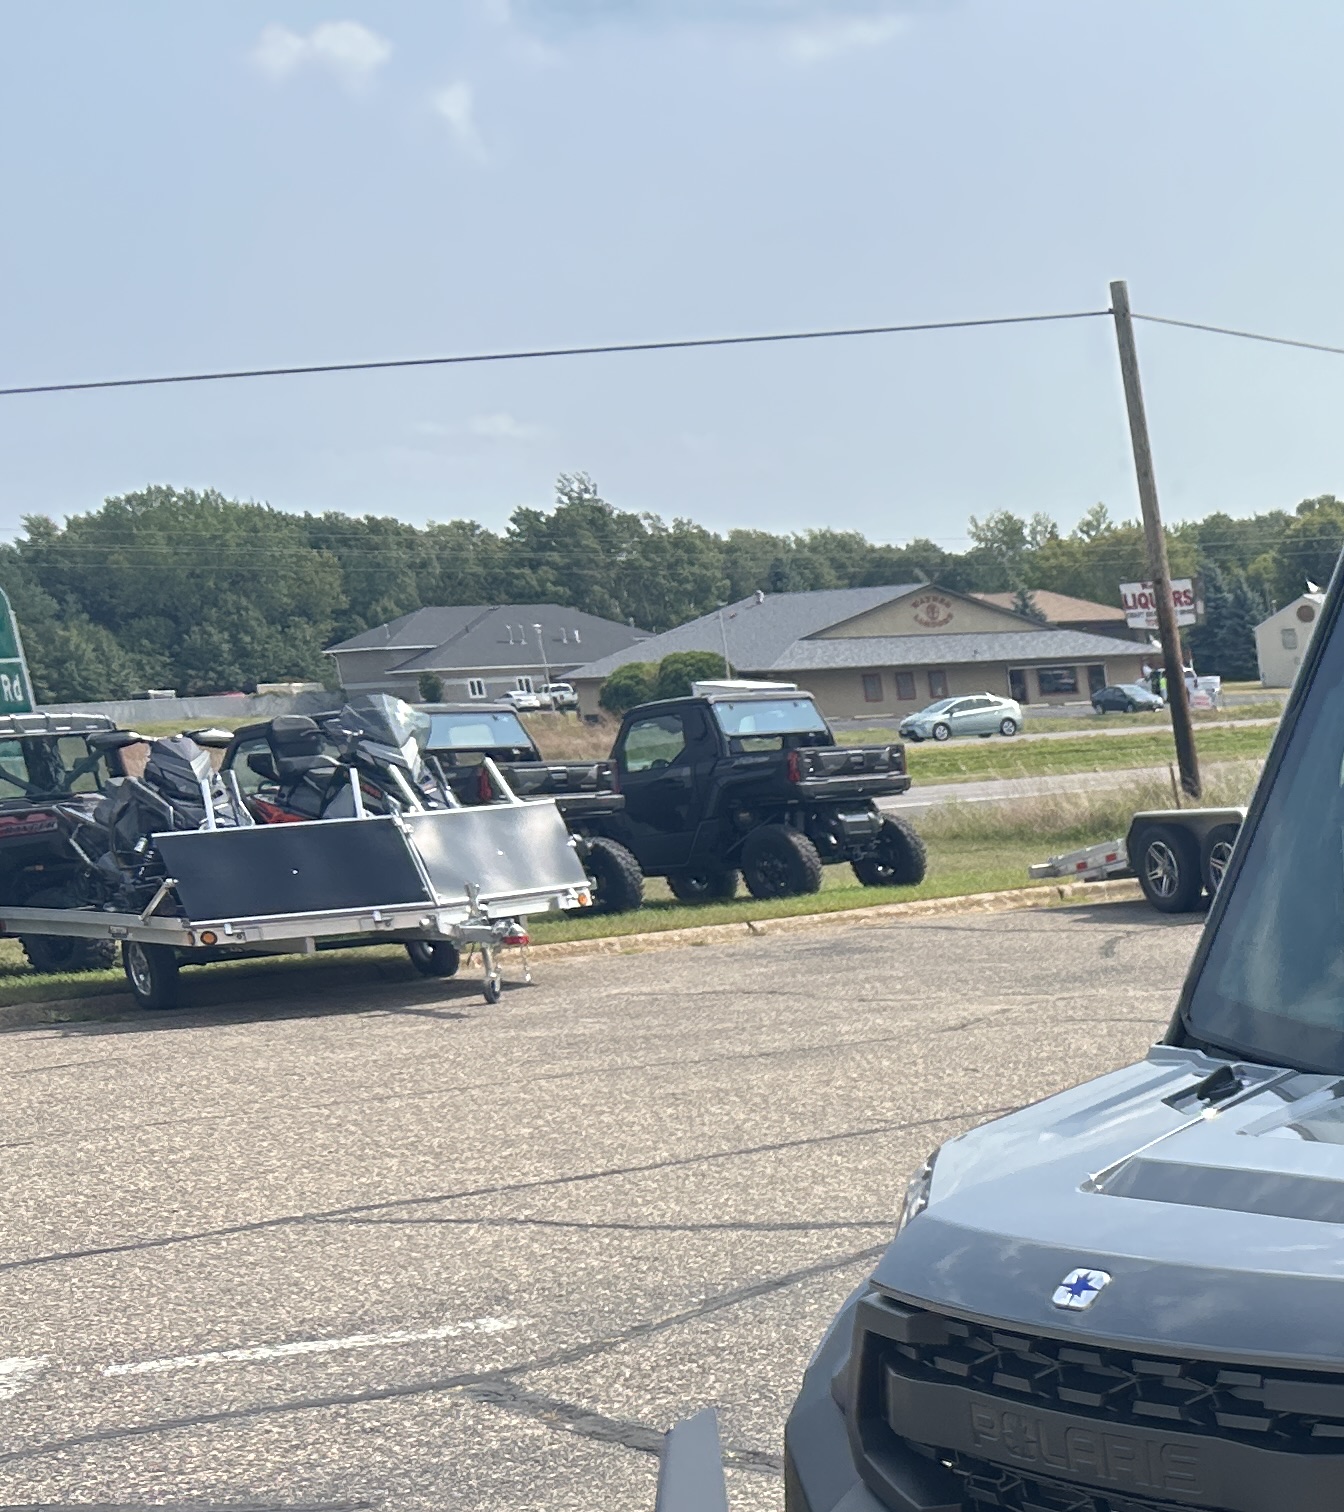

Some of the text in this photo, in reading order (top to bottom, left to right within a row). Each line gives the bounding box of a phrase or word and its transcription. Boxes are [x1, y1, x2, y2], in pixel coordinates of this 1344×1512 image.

[1122, 588, 1195, 610] LIQURS
[0, 673, 24, 702] Rd
[968, 1401, 1206, 1496] POLARIS
